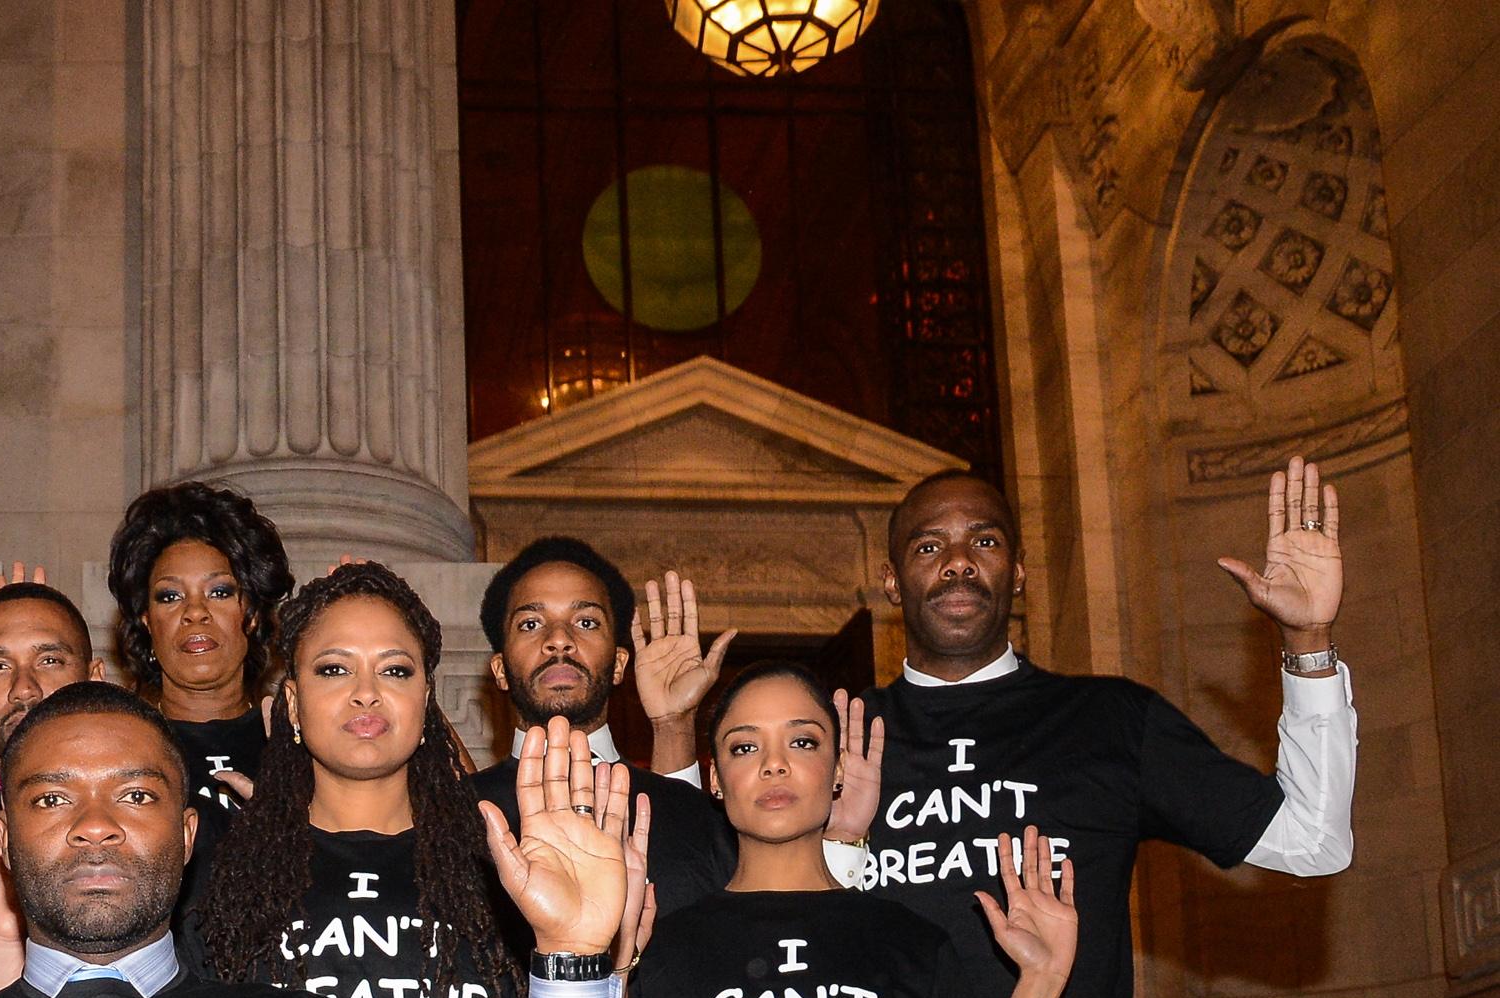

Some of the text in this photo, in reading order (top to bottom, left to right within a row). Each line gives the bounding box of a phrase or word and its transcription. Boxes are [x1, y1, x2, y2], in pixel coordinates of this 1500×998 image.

[205, 755, 234, 775] I
[947, 738, 976, 772] I
[885, 779, 1038, 829] CAN'T
[348, 872, 379, 898] I
[778, 939, 808, 974] I
